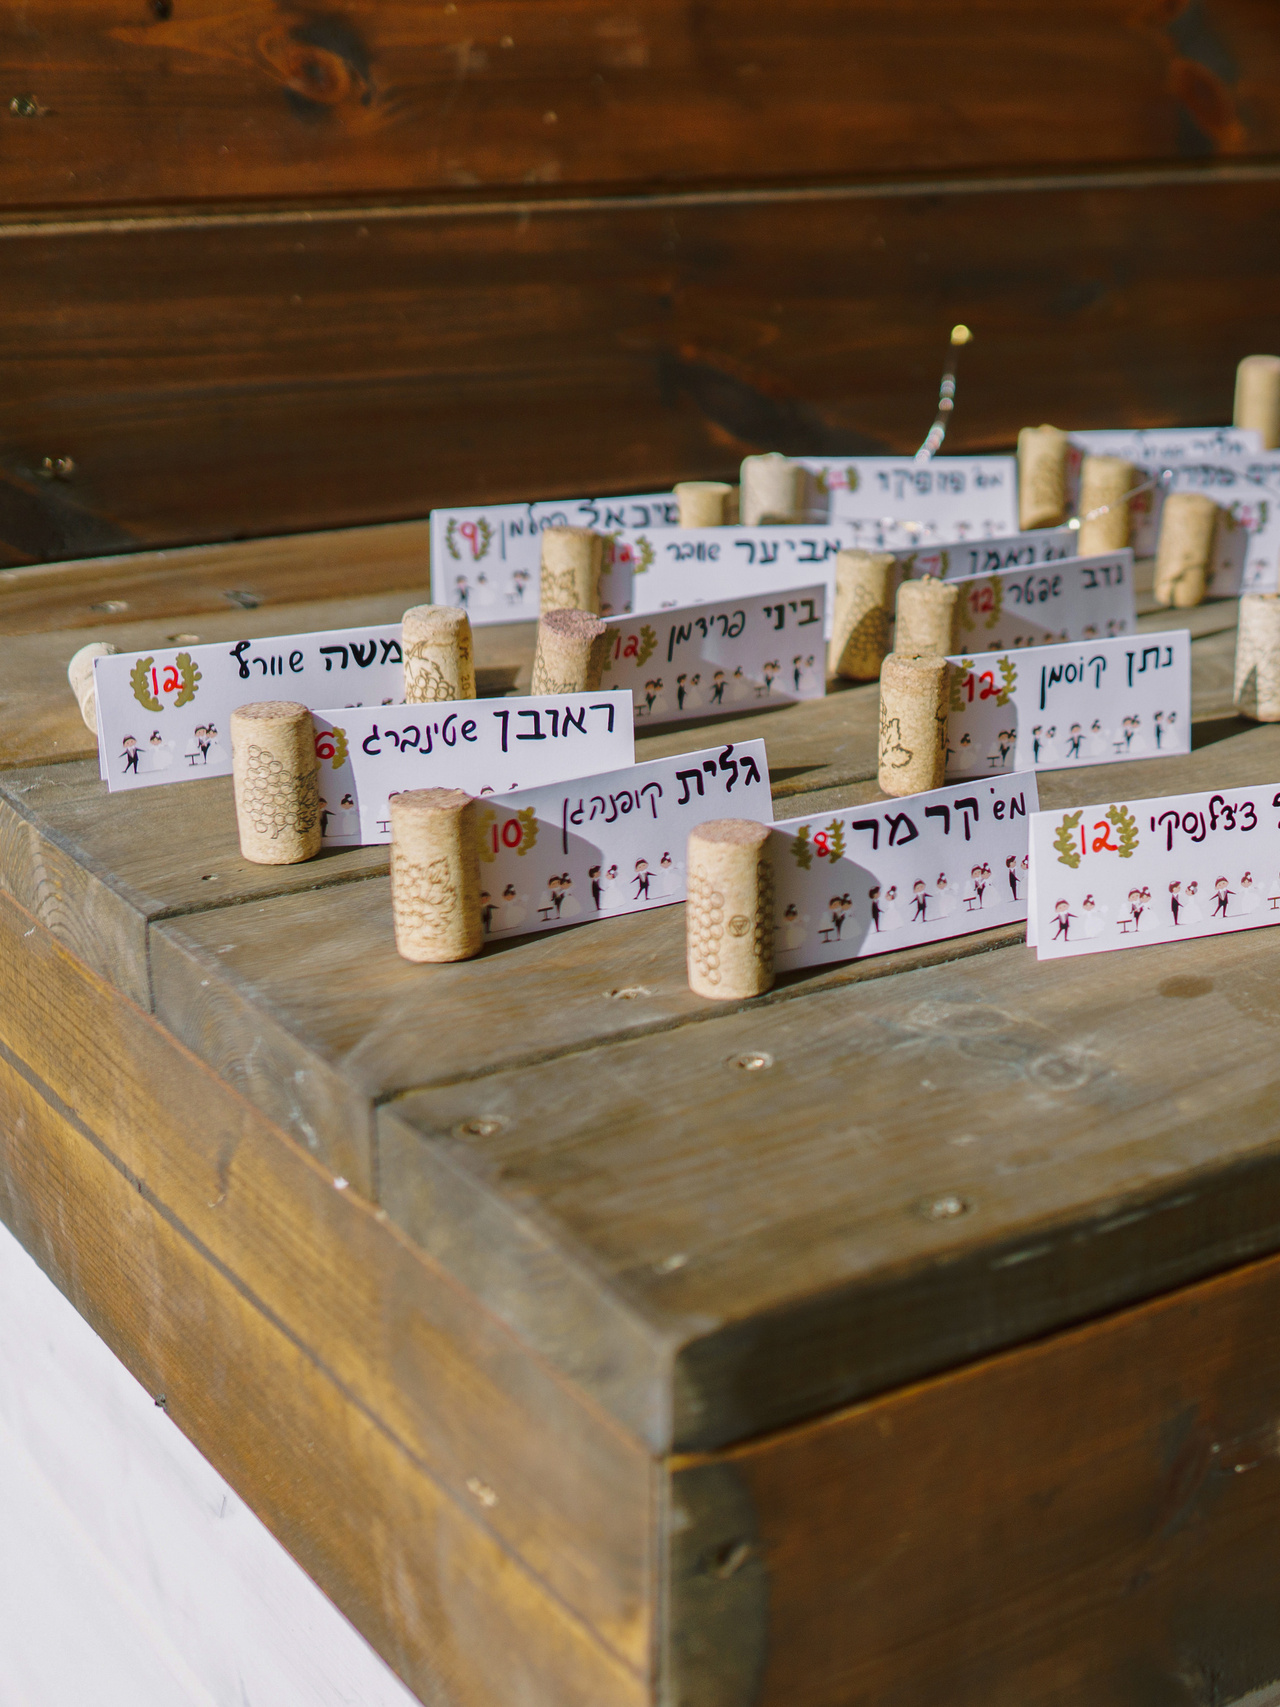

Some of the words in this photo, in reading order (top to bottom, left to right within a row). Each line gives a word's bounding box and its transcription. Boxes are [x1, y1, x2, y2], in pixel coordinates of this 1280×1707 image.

[460, 521, 477, 556] 9
[1081, 564, 1123, 589] נדב
[763, 598, 820, 631] ביני
[969, 587, 995, 613] 12
[614, 635, 640, 661] 12
[667, 610, 746, 663] פרידמן
[320, 638, 404, 672] משה
[1126, 646, 1174, 688] נתן
[152, 665, 184, 696] 12
[961, 670, 1003, 703] 12
[361, 712, 478, 756] שטינברג
[493, 703, 615, 753] ראובן
[676, 744, 762, 806] גלית
[491, 817, 523, 854] 10
[562, 781, 664, 855] קופנהגן
[852, 797, 980, 850] קרמר
[813, 830, 831, 858] 8
[1081, 820, 1119, 855] 12
